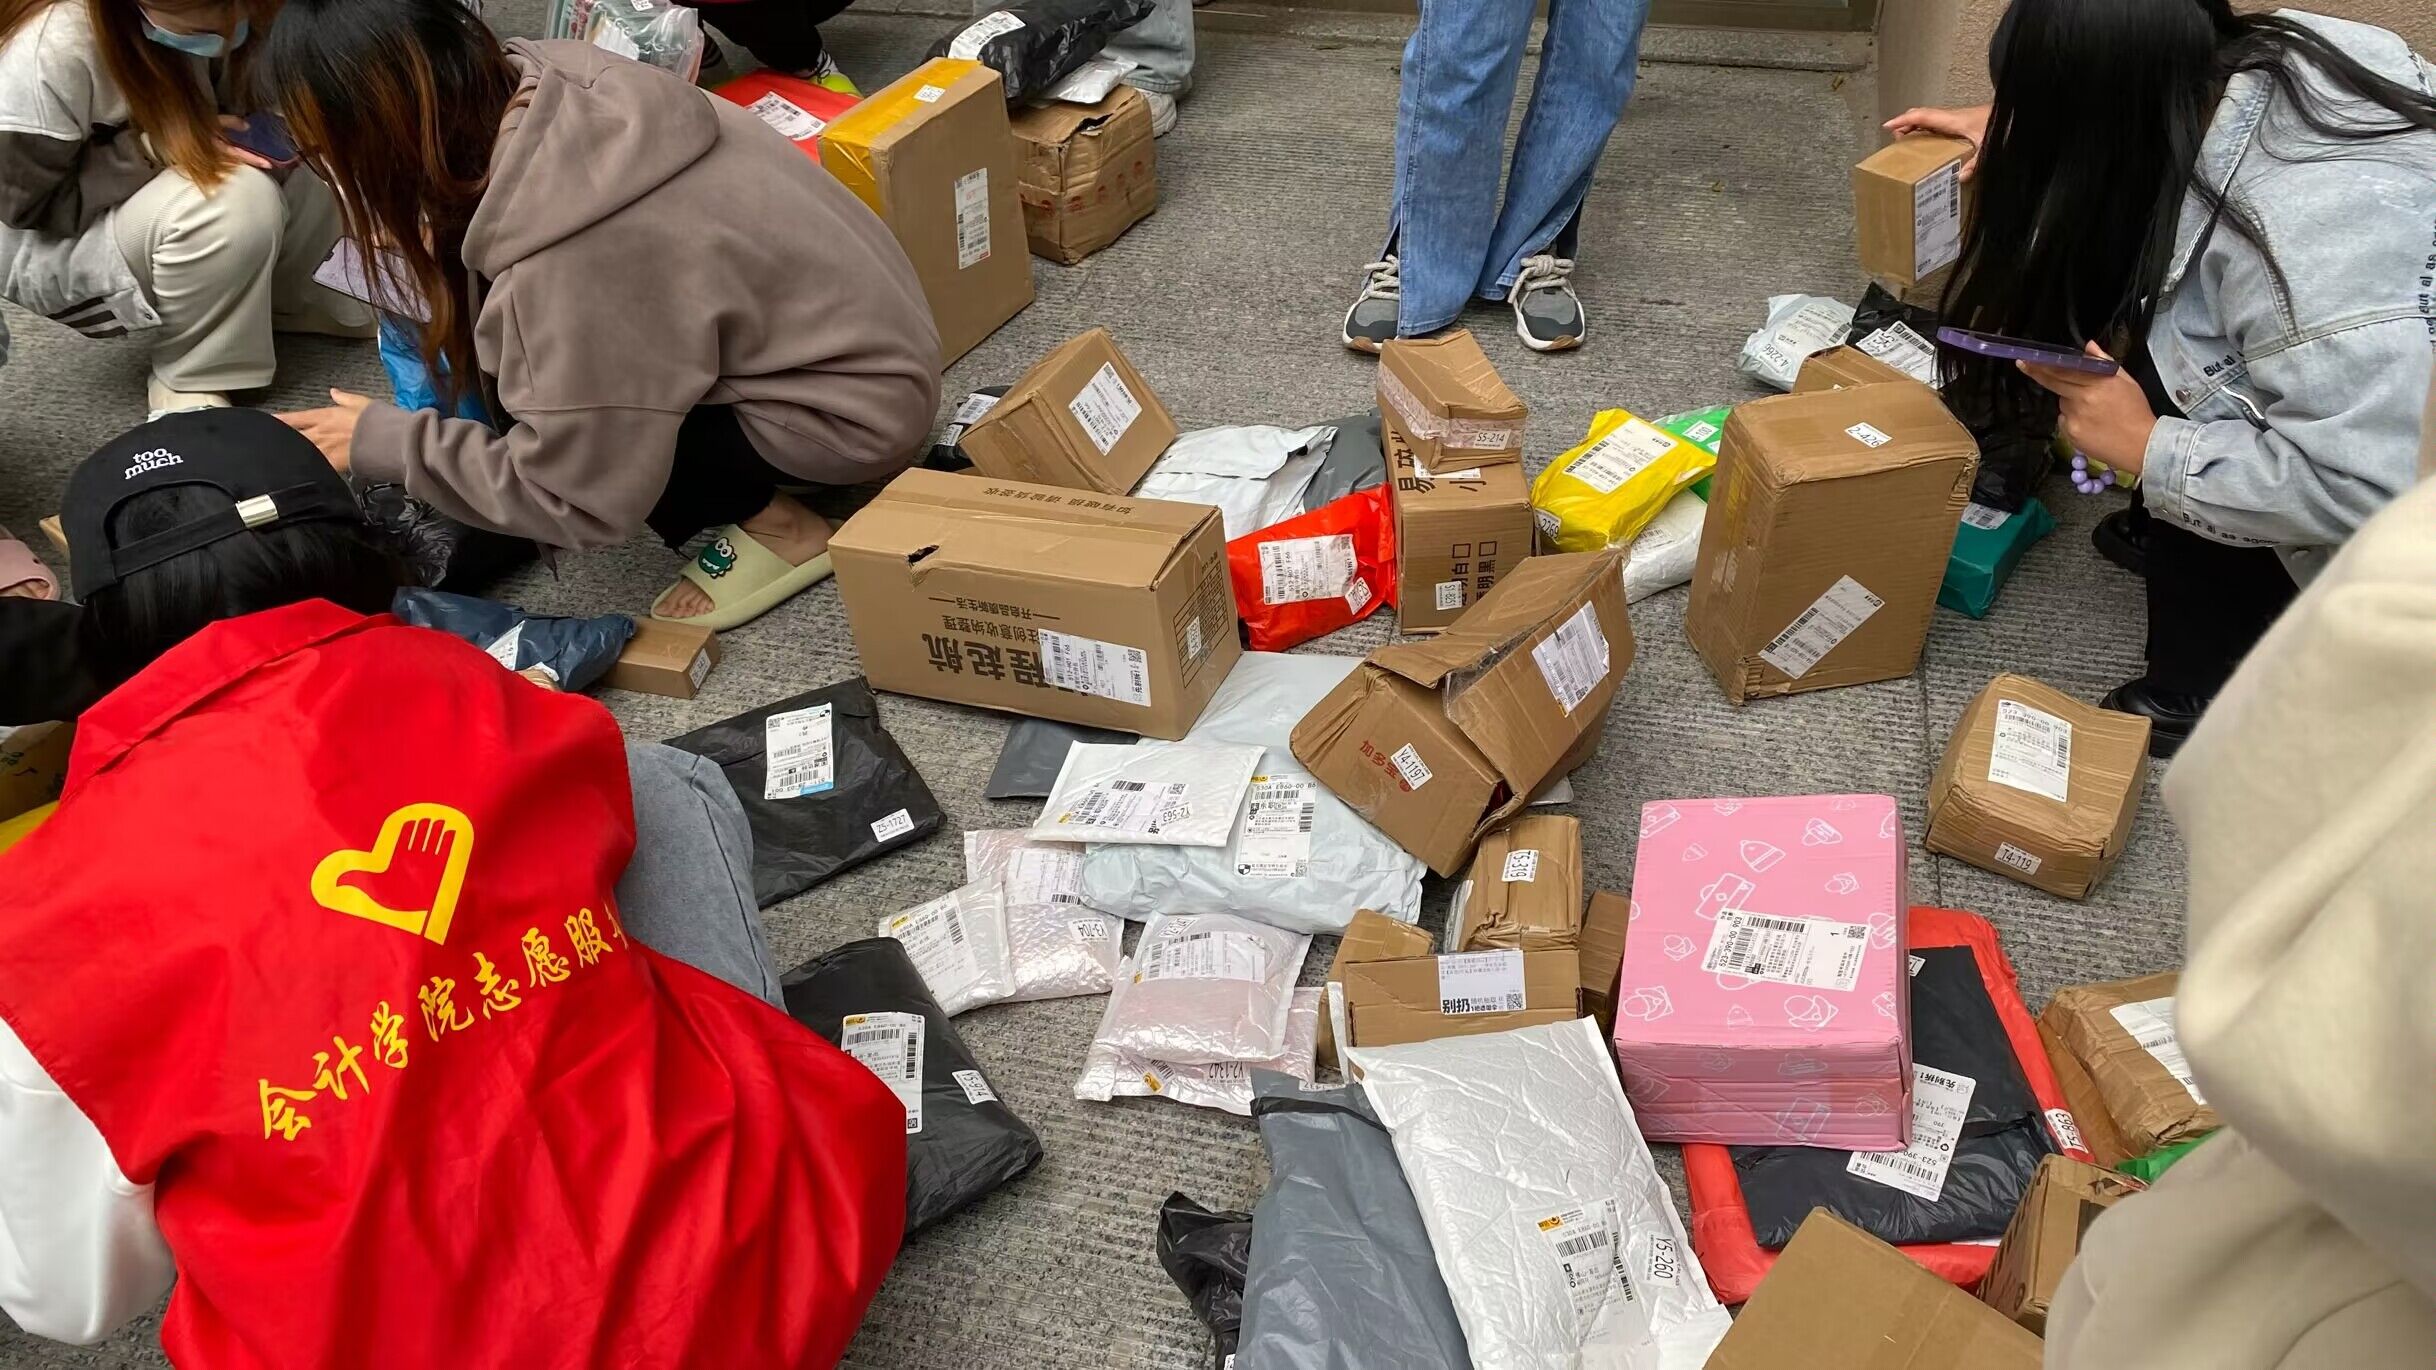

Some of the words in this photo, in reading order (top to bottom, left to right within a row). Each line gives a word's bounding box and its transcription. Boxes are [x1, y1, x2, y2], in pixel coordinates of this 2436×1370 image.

[1763, 344, 1789, 367] 4-2266
[1848, 427, 1884, 448] 2-426
[124, 453, 184, 480] much
[133, 447, 168, 463] too
[1358, 738, 1400, 778] 加多宝
[1400, 748, 1425, 783] Y4-1197
[1162, 806, 1191, 823] Y2-563
[1512, 851, 1530, 880] T5-319
[2001, 847, 2033, 871] T4-119
[1077, 924, 1109, 938] Y3-704
[1718, 930, 1738, 968] 523-390-00
[1732, 916, 1743, 928] 903
[1442, 997, 1470, 1014] 别扔
[1208, 1062, 1245, 1079] Y2-1342
[1919, 1072, 1957, 1088] 先别拆!
[2055, 1112, 2082, 1150] T5-863
[1653, 1237, 1674, 1280] Y5-260
